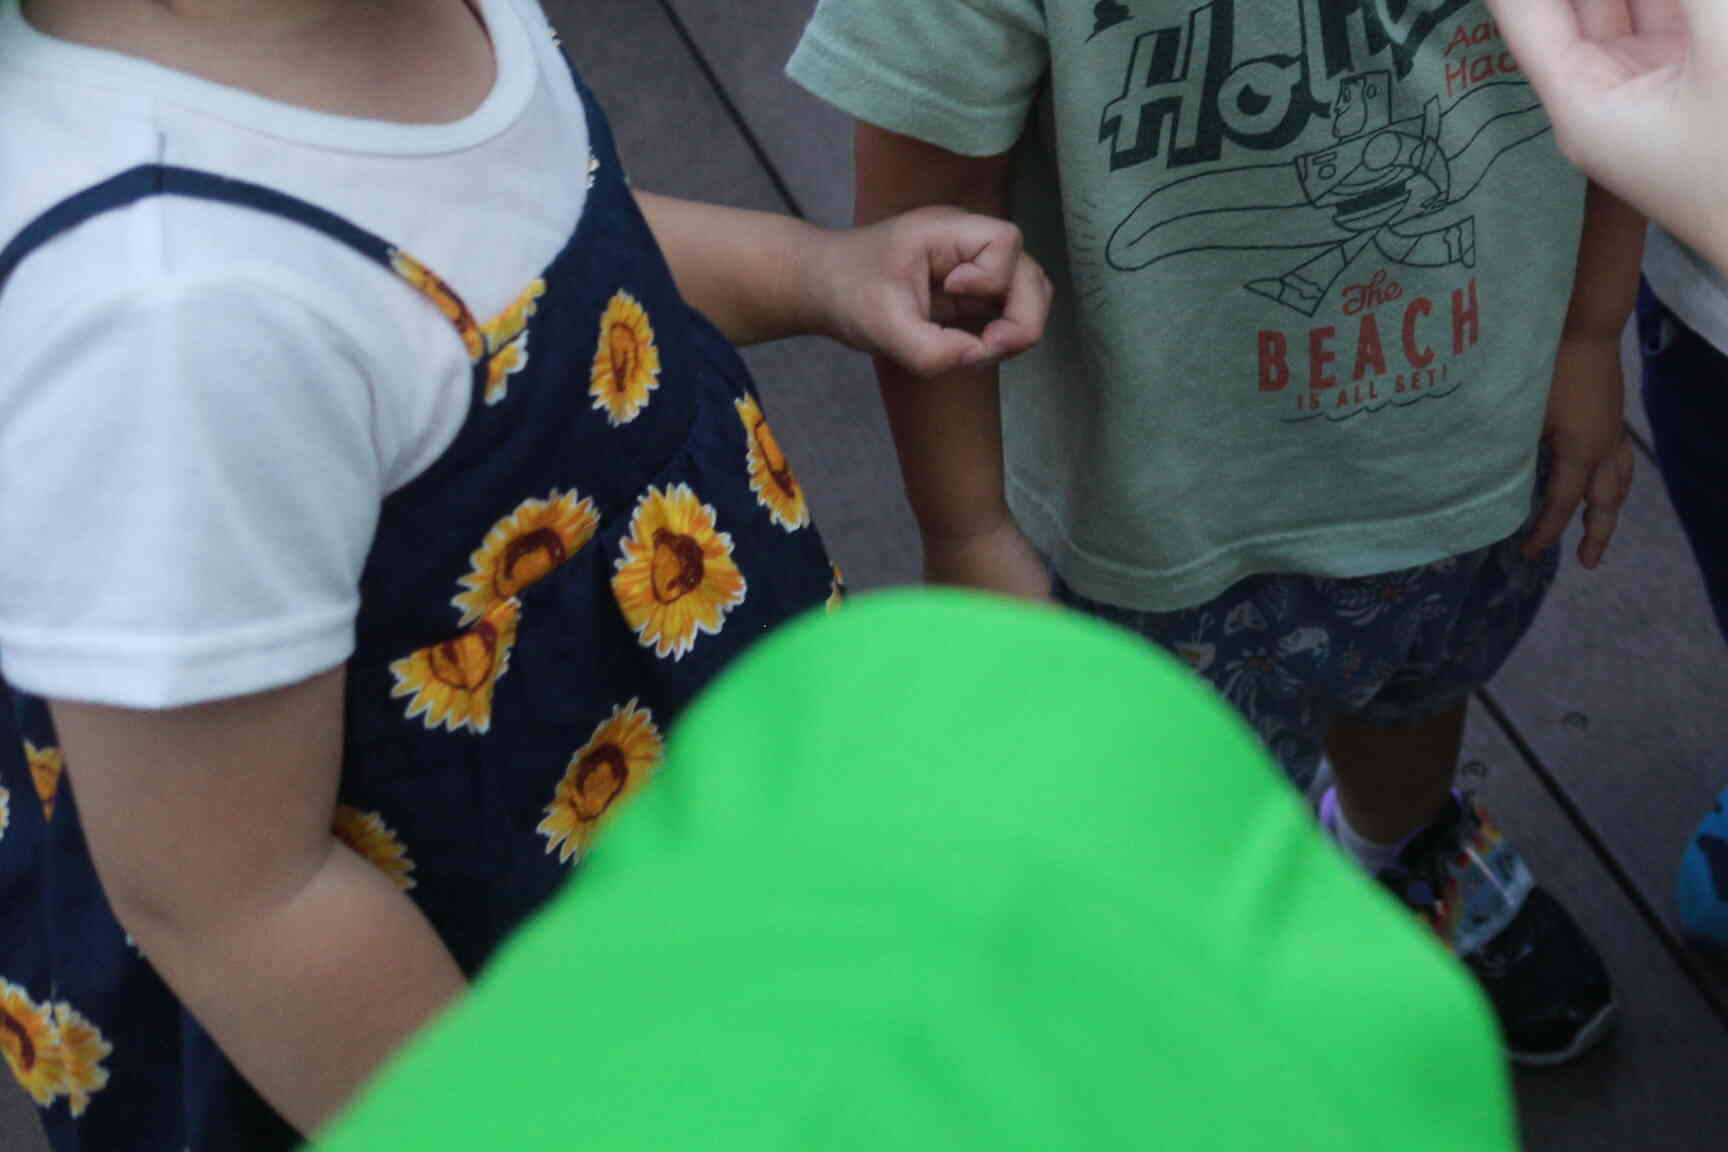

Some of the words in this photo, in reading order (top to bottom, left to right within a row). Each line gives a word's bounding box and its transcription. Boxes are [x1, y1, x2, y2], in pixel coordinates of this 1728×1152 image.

[1342, 269, 1402, 316] The
[1257, 279, 1479, 393] BEACH
[1296, 394, 1321, 411] IS
[1336, 381, 1378, 408] ALL
[1395, 363, 1448, 393] SET!
